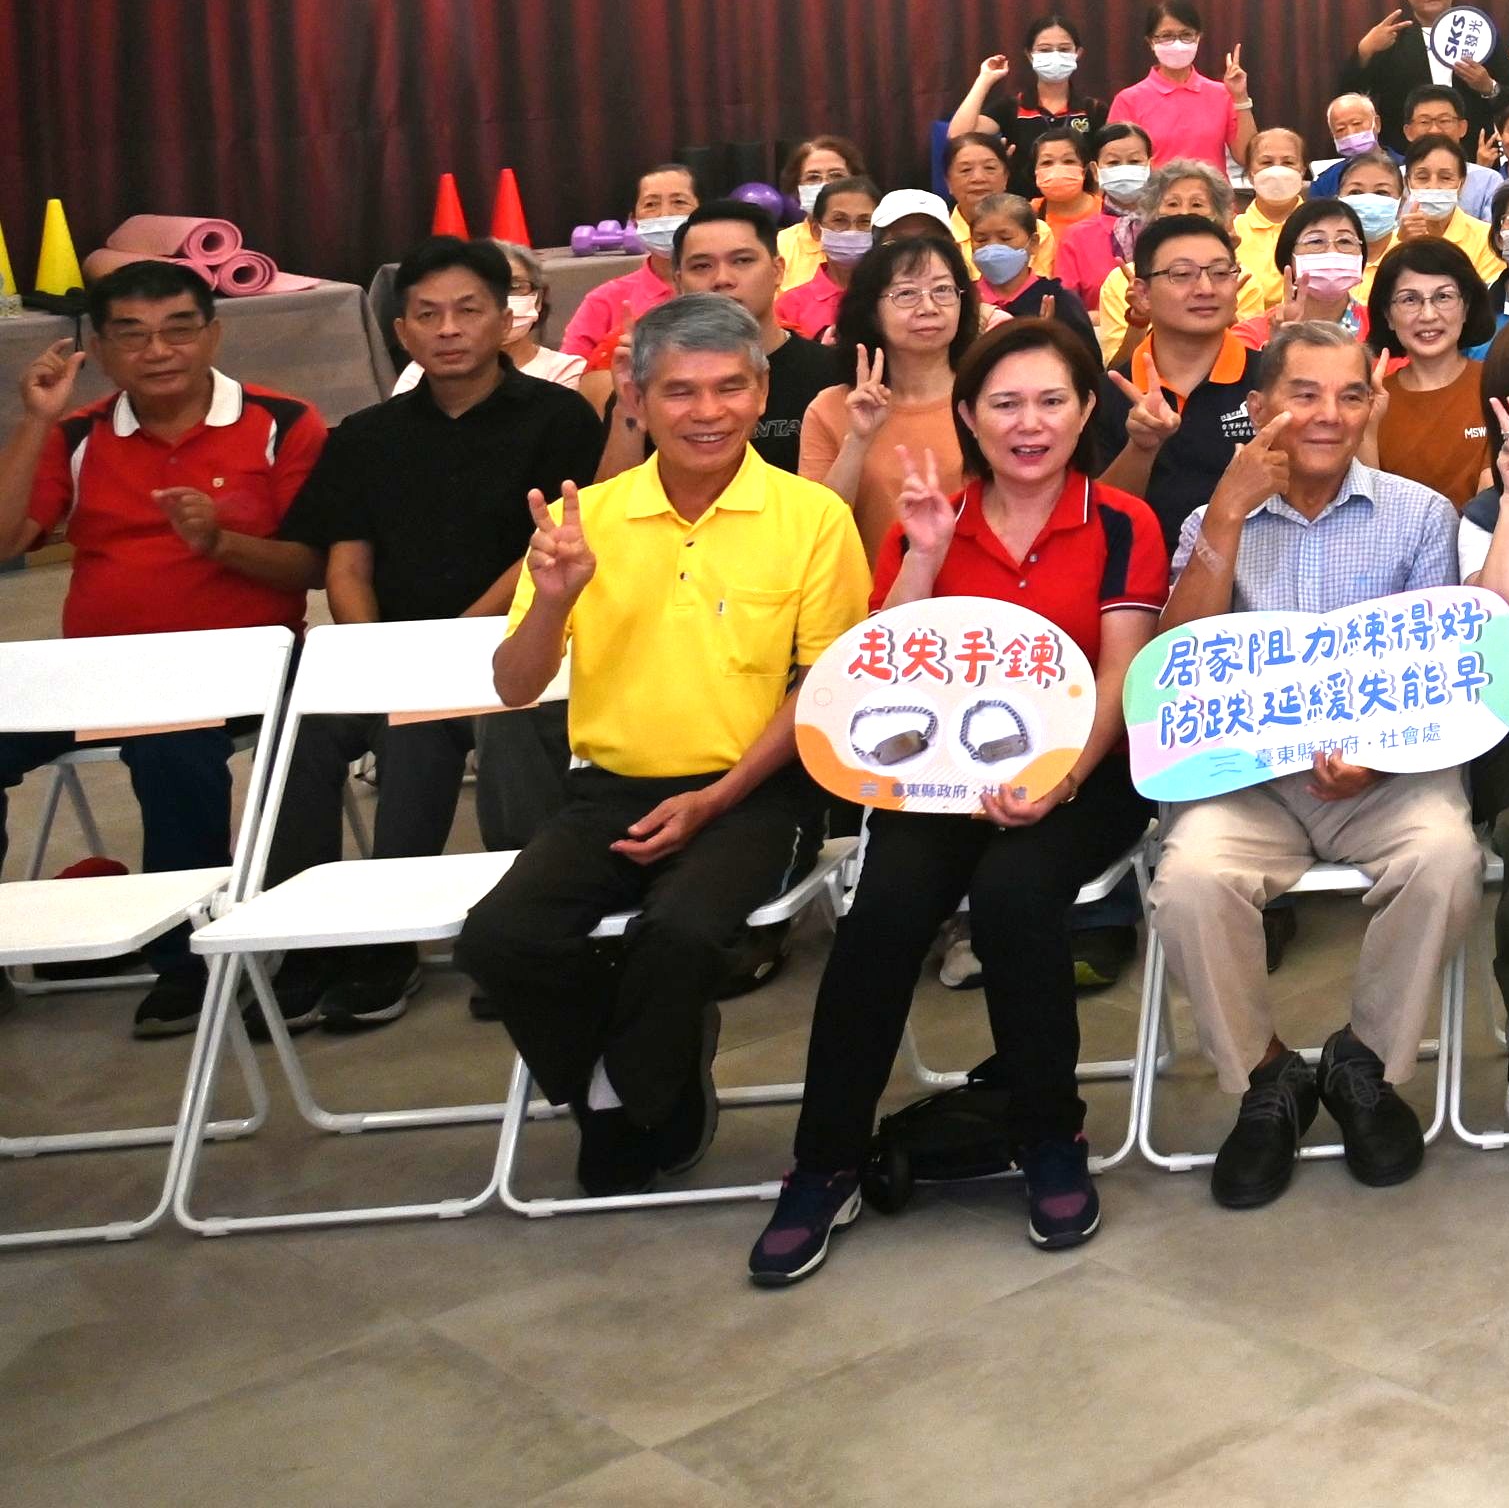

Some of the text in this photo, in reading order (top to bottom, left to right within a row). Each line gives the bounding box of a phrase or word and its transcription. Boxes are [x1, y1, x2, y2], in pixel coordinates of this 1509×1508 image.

[1444, 14, 1466, 59] SKS
[1465, 427, 1487, 439] MSW
[1160, 601, 1485, 687] 居家阻力練得好
[1161, 651, 1489, 746] 防跌延緩失能早
